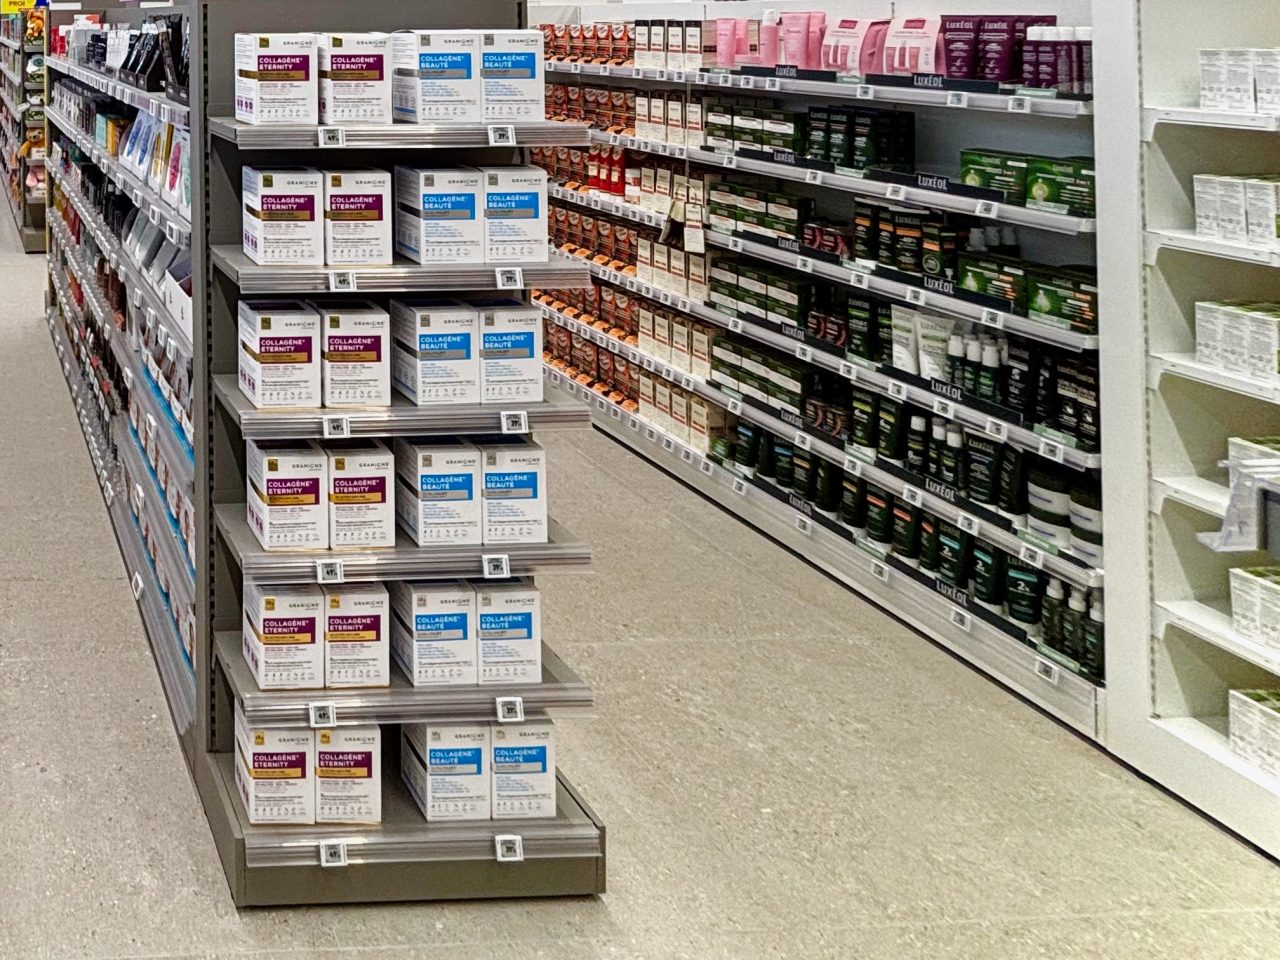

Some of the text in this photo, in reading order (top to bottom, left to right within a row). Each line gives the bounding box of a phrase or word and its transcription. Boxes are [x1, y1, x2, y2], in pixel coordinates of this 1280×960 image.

[913, 75, 943, 87] LUXÉOL
[918, 175, 947, 190] LUXÉOL
[923, 276, 954, 294] LUXÉOL
[931, 380, 962, 401] LUXÉOL
[925, 478, 956, 501] LUXÉOL
